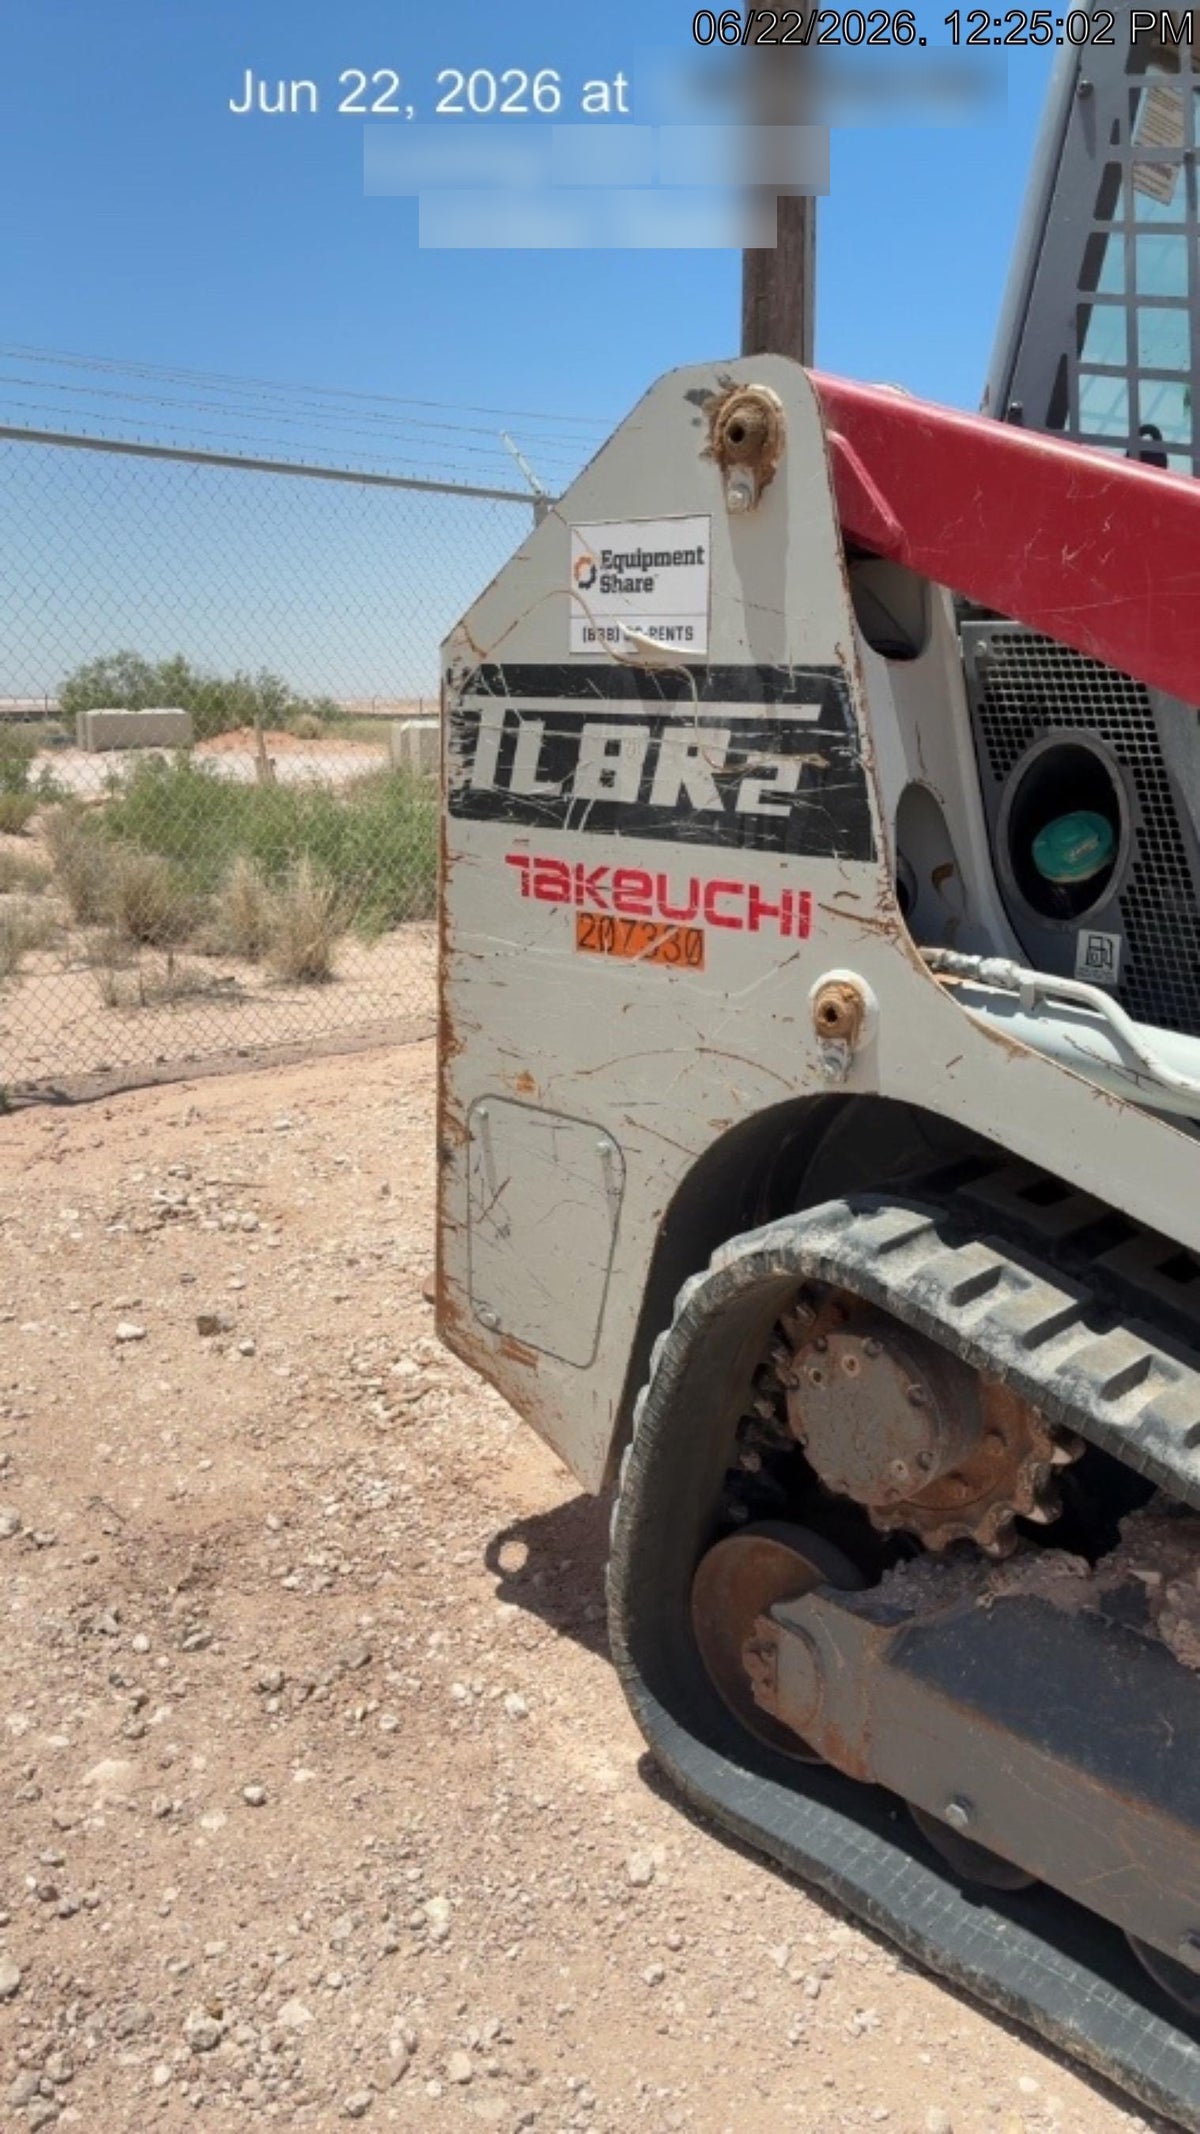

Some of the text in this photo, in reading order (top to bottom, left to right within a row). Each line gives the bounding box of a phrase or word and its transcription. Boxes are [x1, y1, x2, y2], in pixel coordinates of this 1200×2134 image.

[600, 545, 705, 574] Equipment
[600, 573, 654, 593] Share
[623, 624, 694, 641] -RENTS
